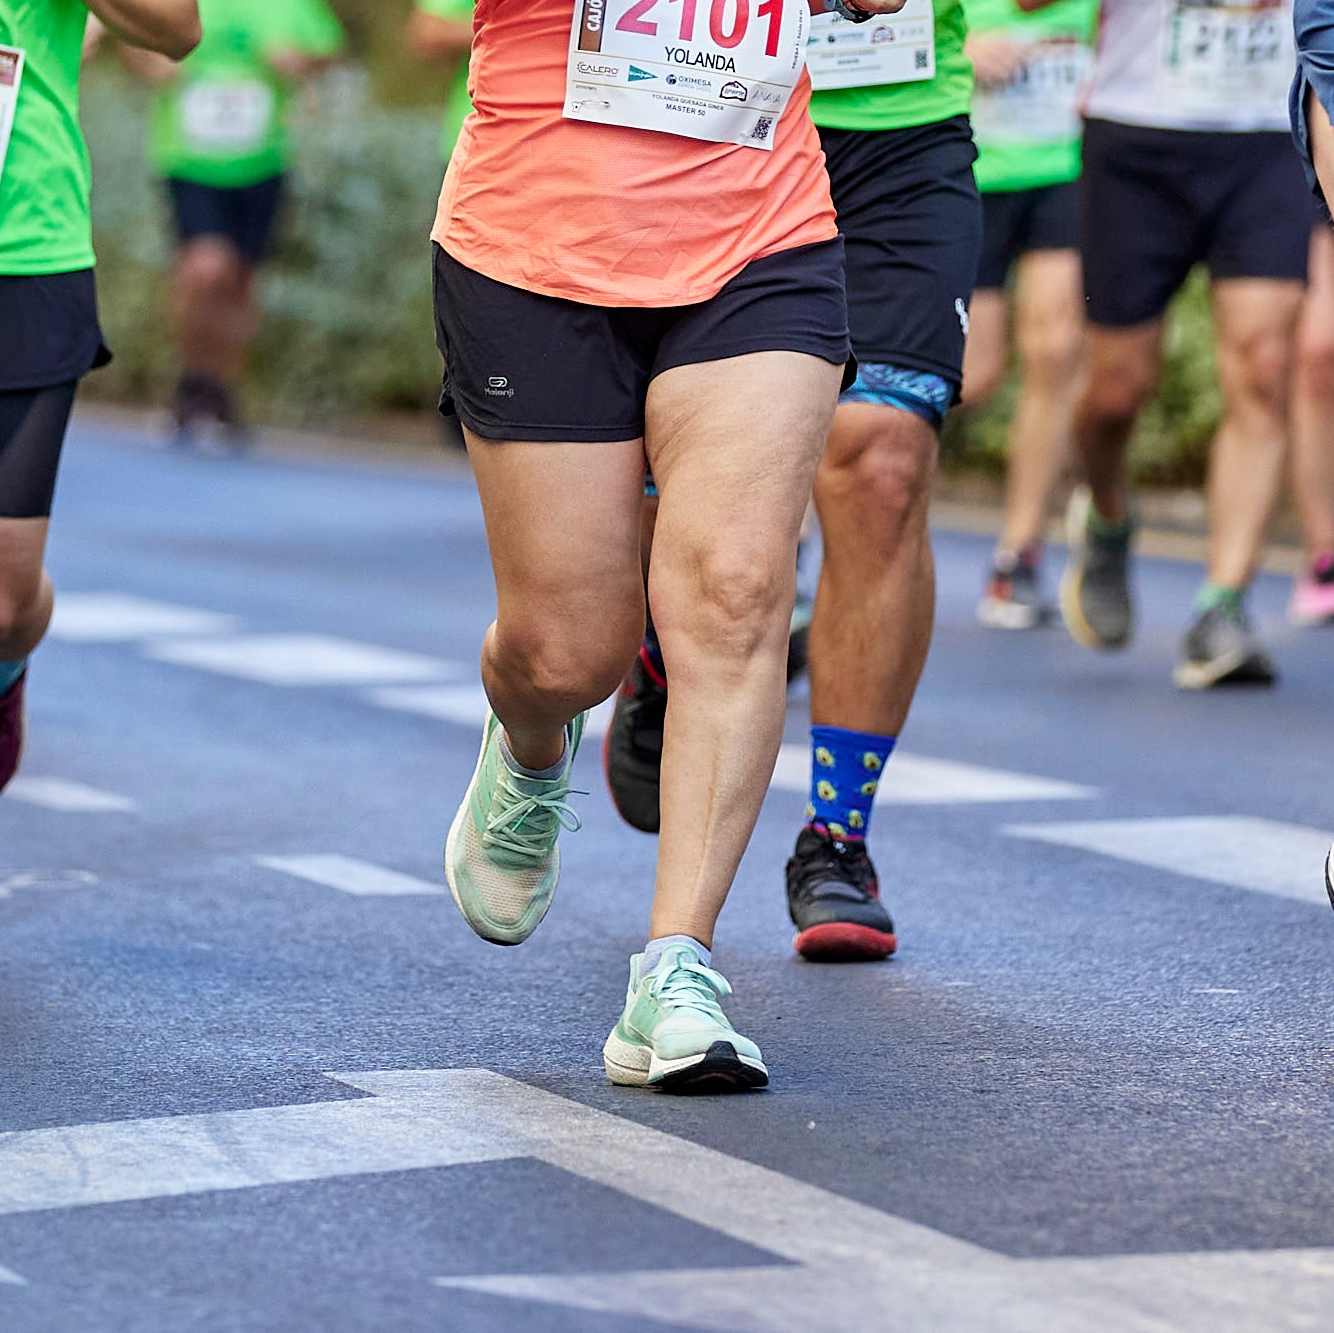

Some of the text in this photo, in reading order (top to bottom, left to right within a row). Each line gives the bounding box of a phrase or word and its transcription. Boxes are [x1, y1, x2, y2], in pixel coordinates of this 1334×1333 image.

[665, 46, 736, 73] YOLANDA
[579, 63, 619, 75] CALERO
[678, 75, 711, 87] OXIMESA
[652, 93, 679, 103] YOLANDA
[680, 98, 707, 108] QUESADA
[665, 103, 706, 117] MASTER 50
